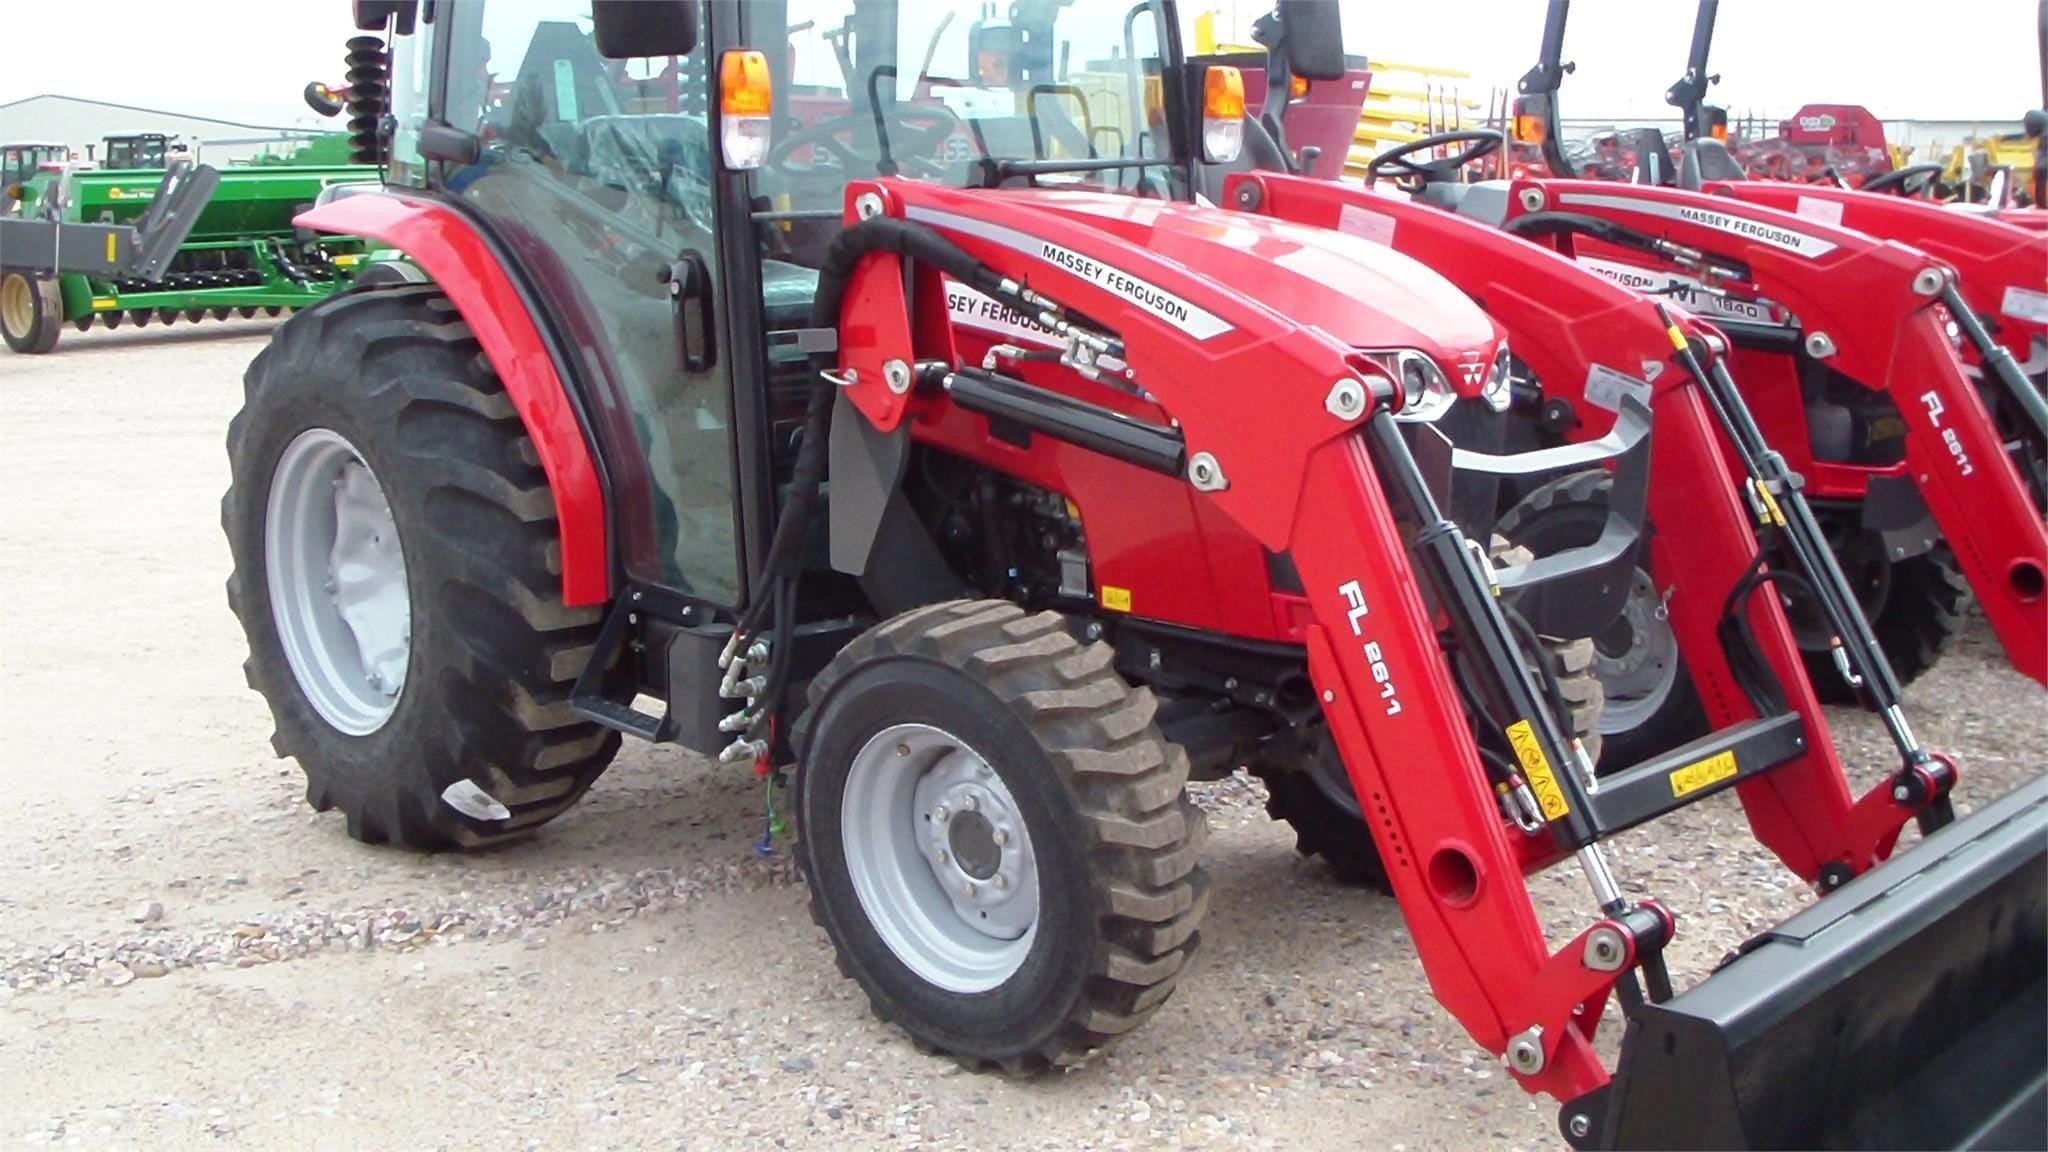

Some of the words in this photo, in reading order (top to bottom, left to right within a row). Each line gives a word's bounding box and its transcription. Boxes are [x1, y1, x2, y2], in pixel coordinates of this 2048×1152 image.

[1680, 209, 1730, 227] MASSEY
[1734, 221, 1801, 248] FERGUSON
[1043, 244, 1103, 280] MASSEY
[1107, 272, 1188, 322] FERGUSON
[947, 294, 977, 314] SEY
[980, 302, 1064, 338] FERGUS
[1921, 390, 1944, 428] FL
[1339, 580, 1368, 636] FL
[1363, 641, 1402, 716] 2611
